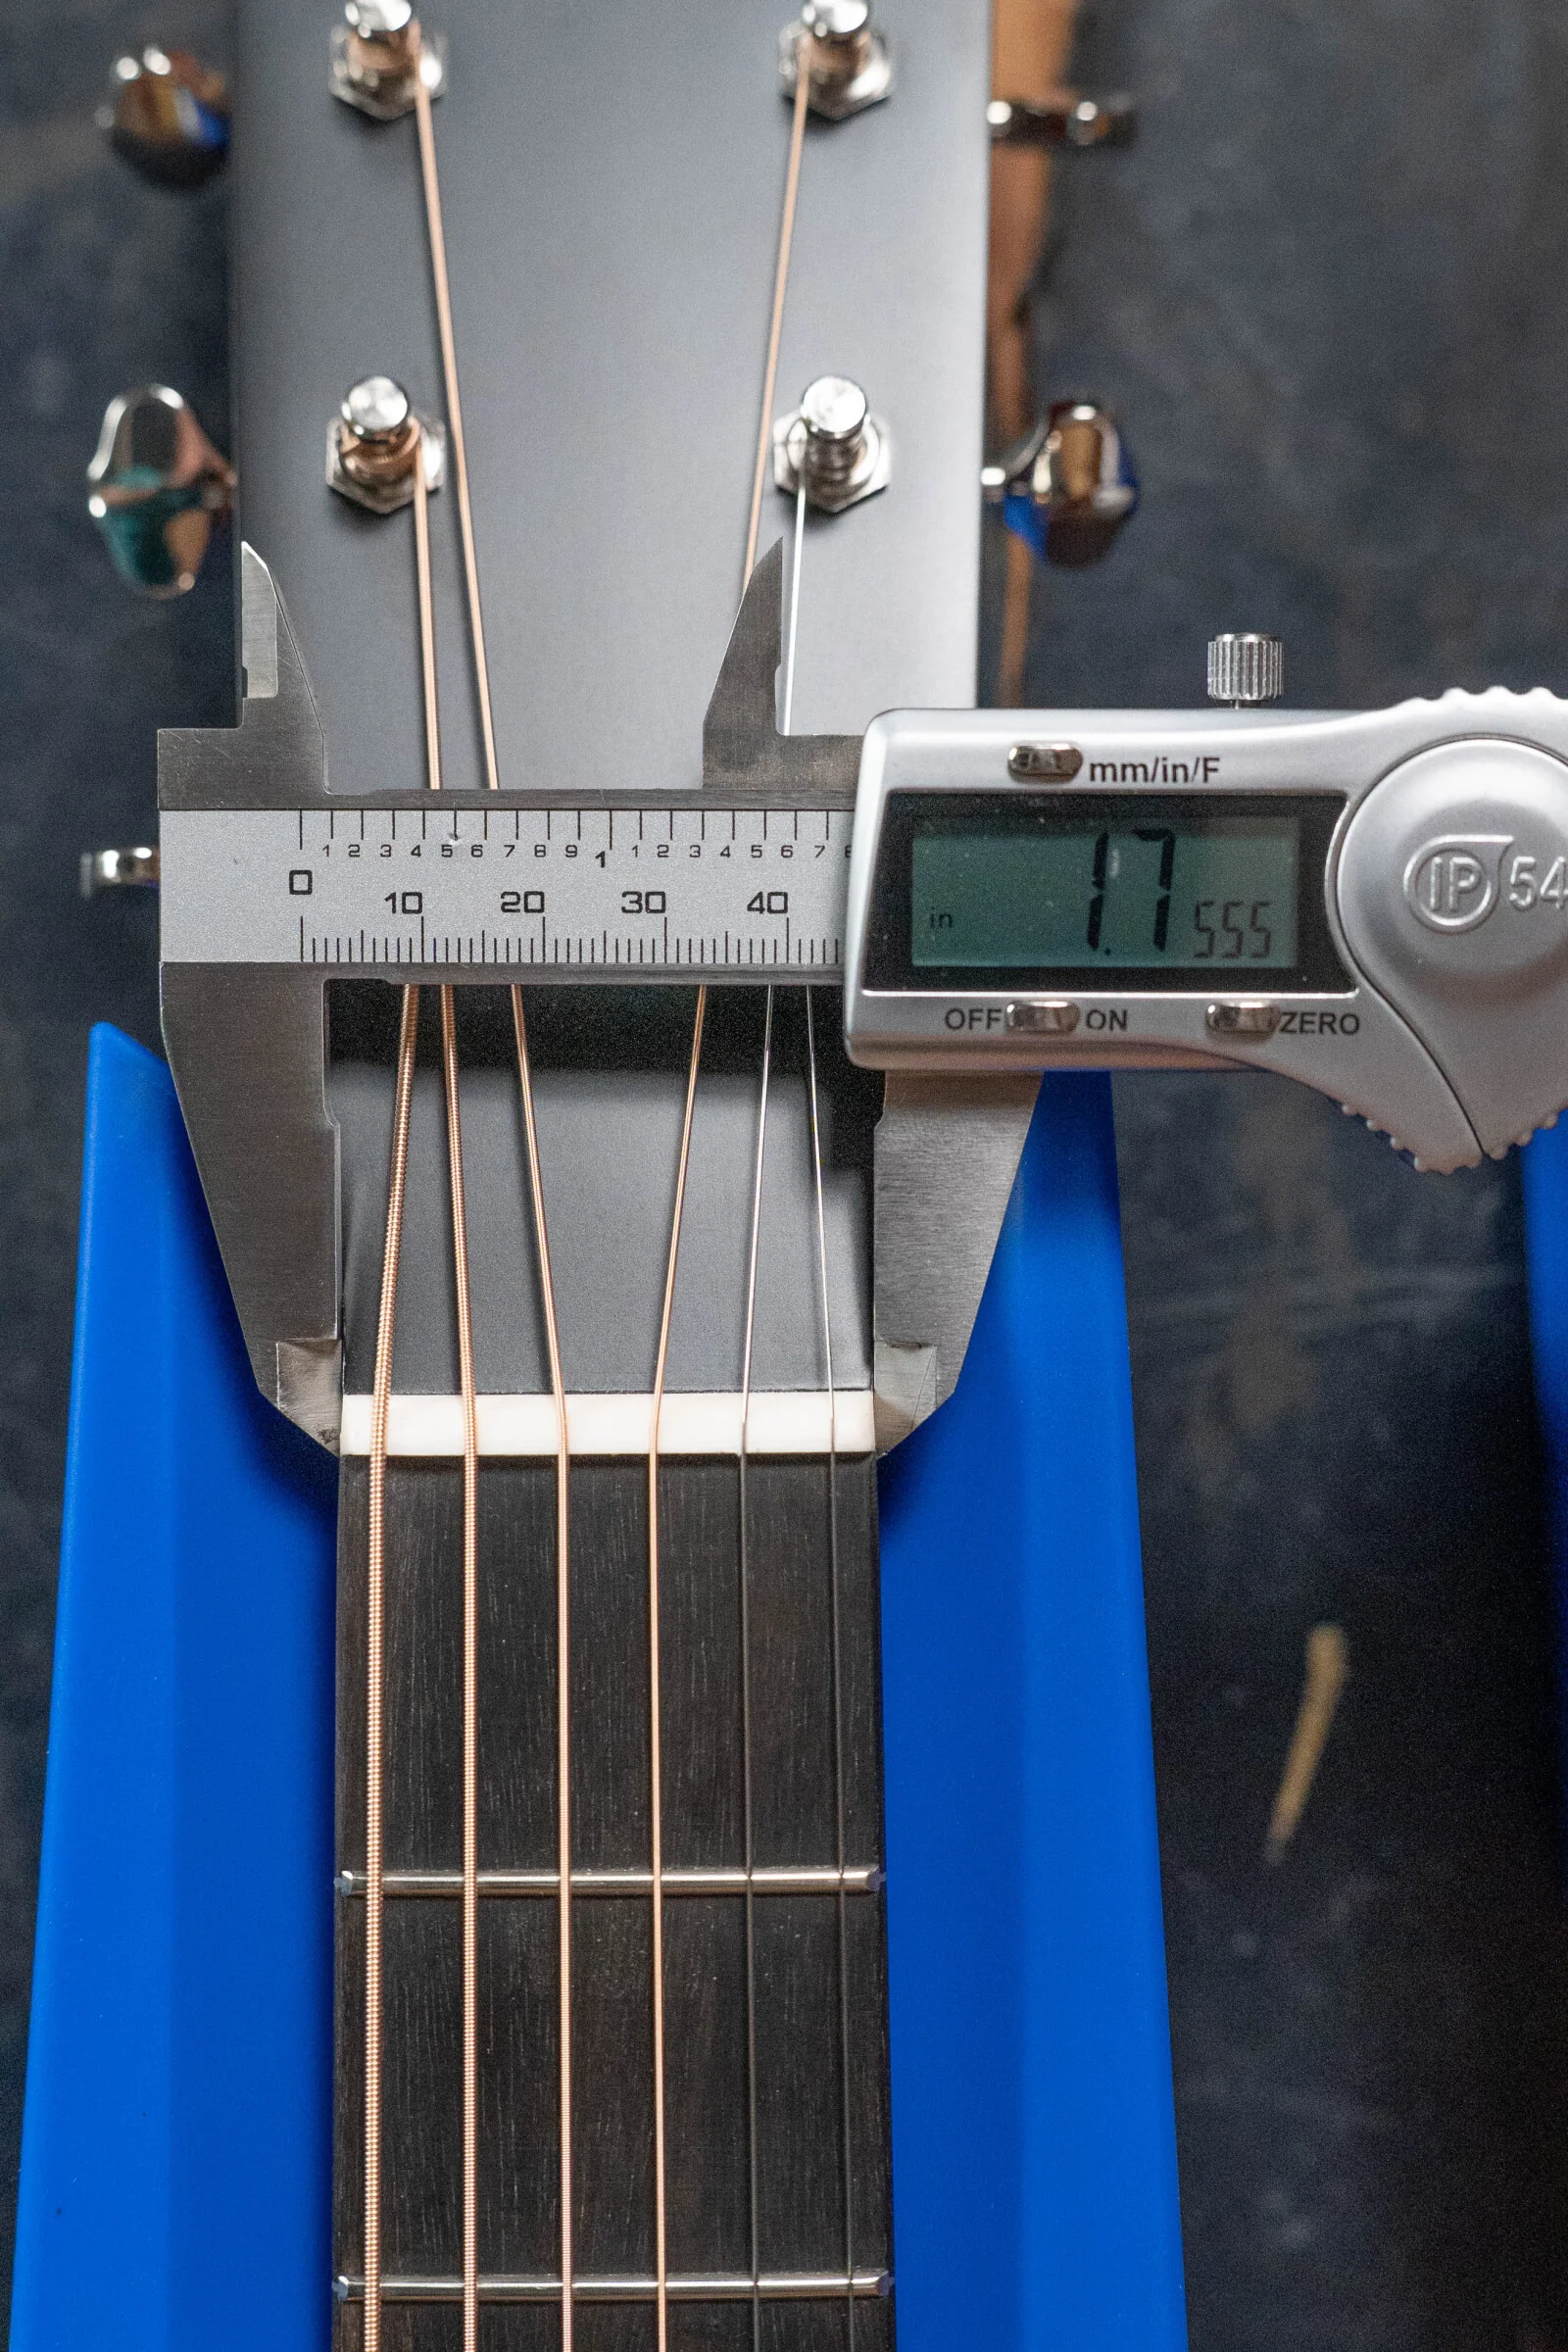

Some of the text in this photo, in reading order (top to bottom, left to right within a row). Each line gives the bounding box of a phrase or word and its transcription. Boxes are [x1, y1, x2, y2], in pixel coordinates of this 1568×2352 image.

[1089, 757, 1220, 783] mm/in/F
[321, 845, 329, 858] 1
[348, 845, 361, 858] 2
[379, 845, 392, 858] 3
[411, 845, 421, 858] 4
[441, 845, 453, 858] 5
[470, 845, 483, 858] 6
[504, 845, 515, 858] 7
[534, 845, 547, 858] 8
[564, 845, 578, 858] 9
[595, 851, 606, 868] 1
[631, 845, 639, 858] 1
[657, 845, 669, 858] 2
[689, 845, 702, 858] 3
[719, 845, 731, 858] 4
[751, 845, 763, 858] 5
[780, 845, 793, 858] 6
[813, 845, 825, 858] 7
[288, 869, 313, 895] 0
[1430, 856, 1568, 912] IP 54
[383, 890, 789, 914] 10 20 30 40
[929, 907, 953, 929] in
[945, 1007, 1360, 1036] OFF ON ZERO
